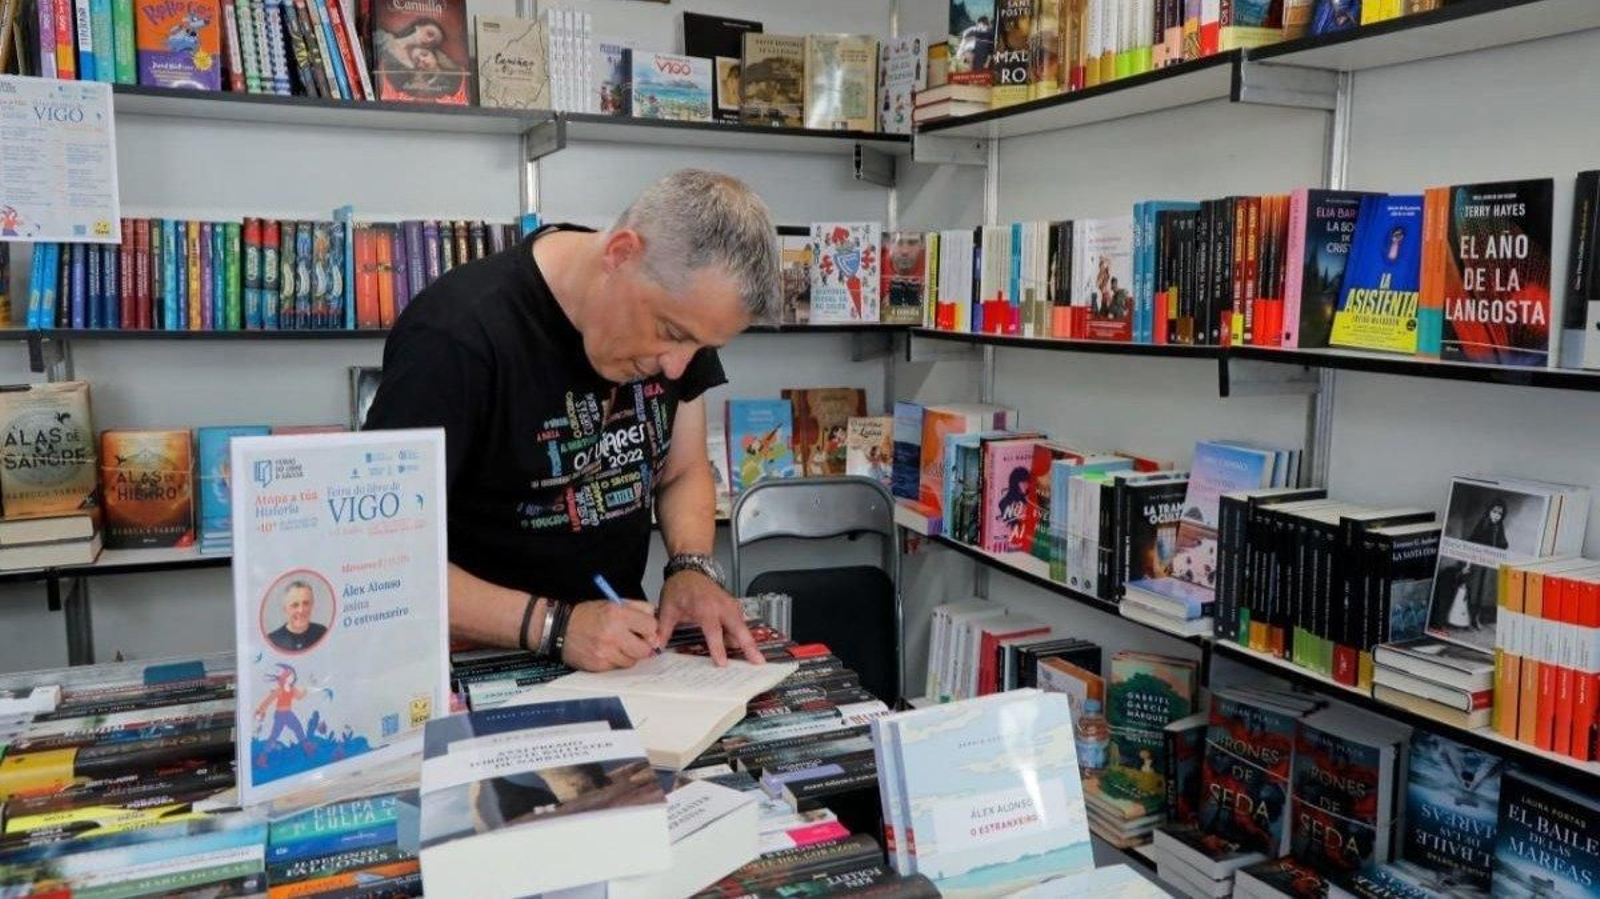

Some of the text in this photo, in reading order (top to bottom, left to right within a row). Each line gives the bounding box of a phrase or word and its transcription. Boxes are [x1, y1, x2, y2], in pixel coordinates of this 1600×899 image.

[34, 106, 84, 123] VIGO
[1316, 206, 1336, 218] ELIA
[1464, 202, 1526, 218] TERRY HAYES
[1326, 220, 1340, 232] LA
[1460, 230, 1529, 260] EL AÑO
[1380, 272, 1392, 290] LA
[1463, 267, 1521, 292] DE LA
[1343, 288, 1420, 318] ASISTENTA
[1445, 296, 1547, 326] LANGOSTA
[4, 427, 62, 448] ALAS
[4, 447, 87, 470] SANGRE
[608, 448, 644, 469] 2022
[328, 491, 400, 524] VIGO
[1143, 504, 1156, 517] LA
[1209, 783, 1270, 820] SEDA
[315, 811, 376, 831] CULPA
[1508, 803, 1600, 857] EL BAILE
[1299, 813, 1360, 855] SEDA
[1508, 836, 1593, 886] MAREAS
